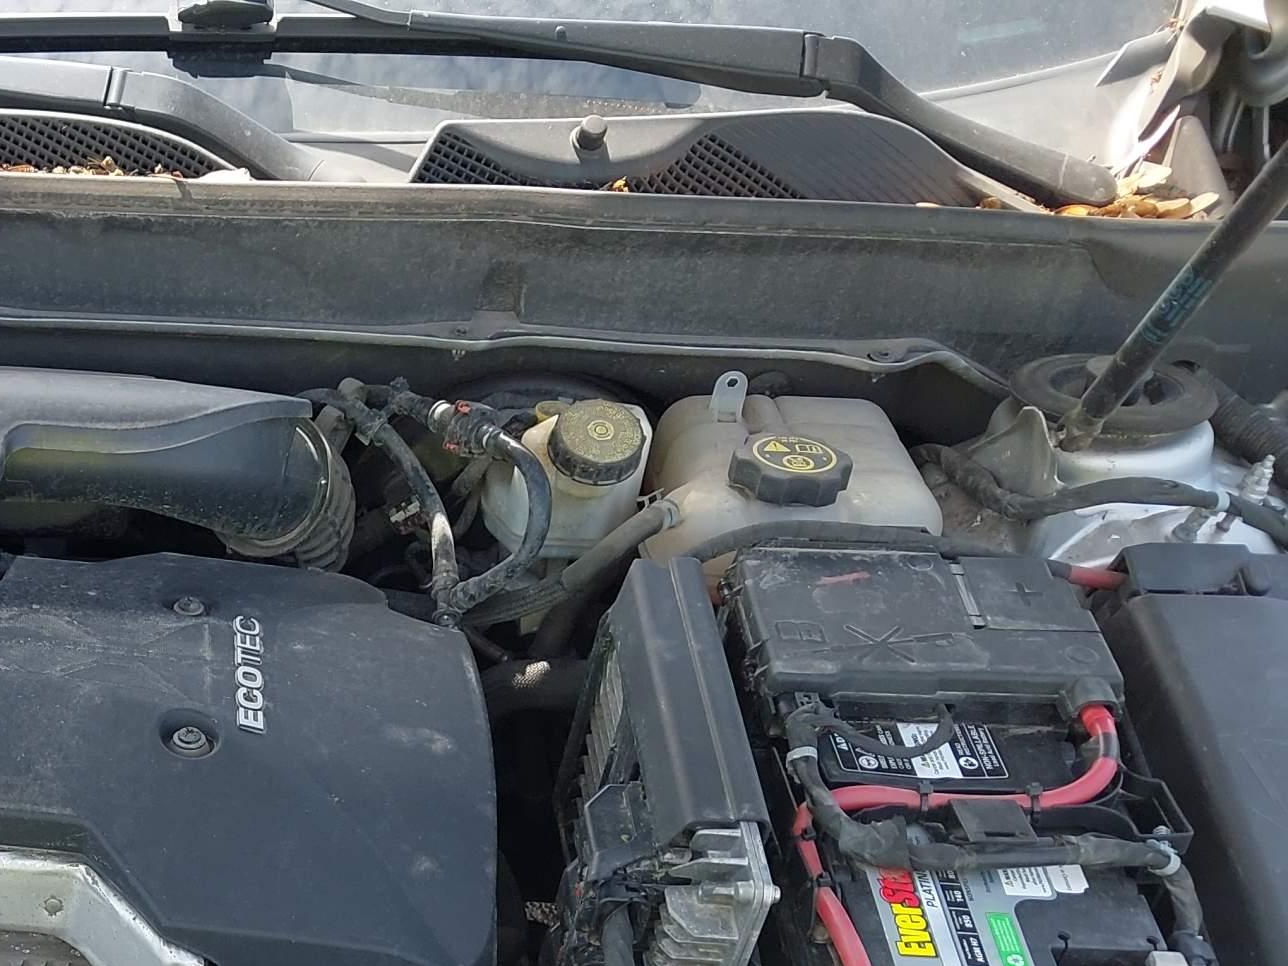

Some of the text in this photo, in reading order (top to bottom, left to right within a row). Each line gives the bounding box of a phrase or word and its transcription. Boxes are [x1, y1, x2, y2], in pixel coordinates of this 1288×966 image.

[234, 615, 265, 734] ECOTEC
[967, 724, 995, 770] NON-SPILLABLE
[916, 870, 939, 908] PLATIN
[954, 890, 964, 902] 140
[962, 914, 973, 928] 850
[970, 937, 985, 963] AGM H7
